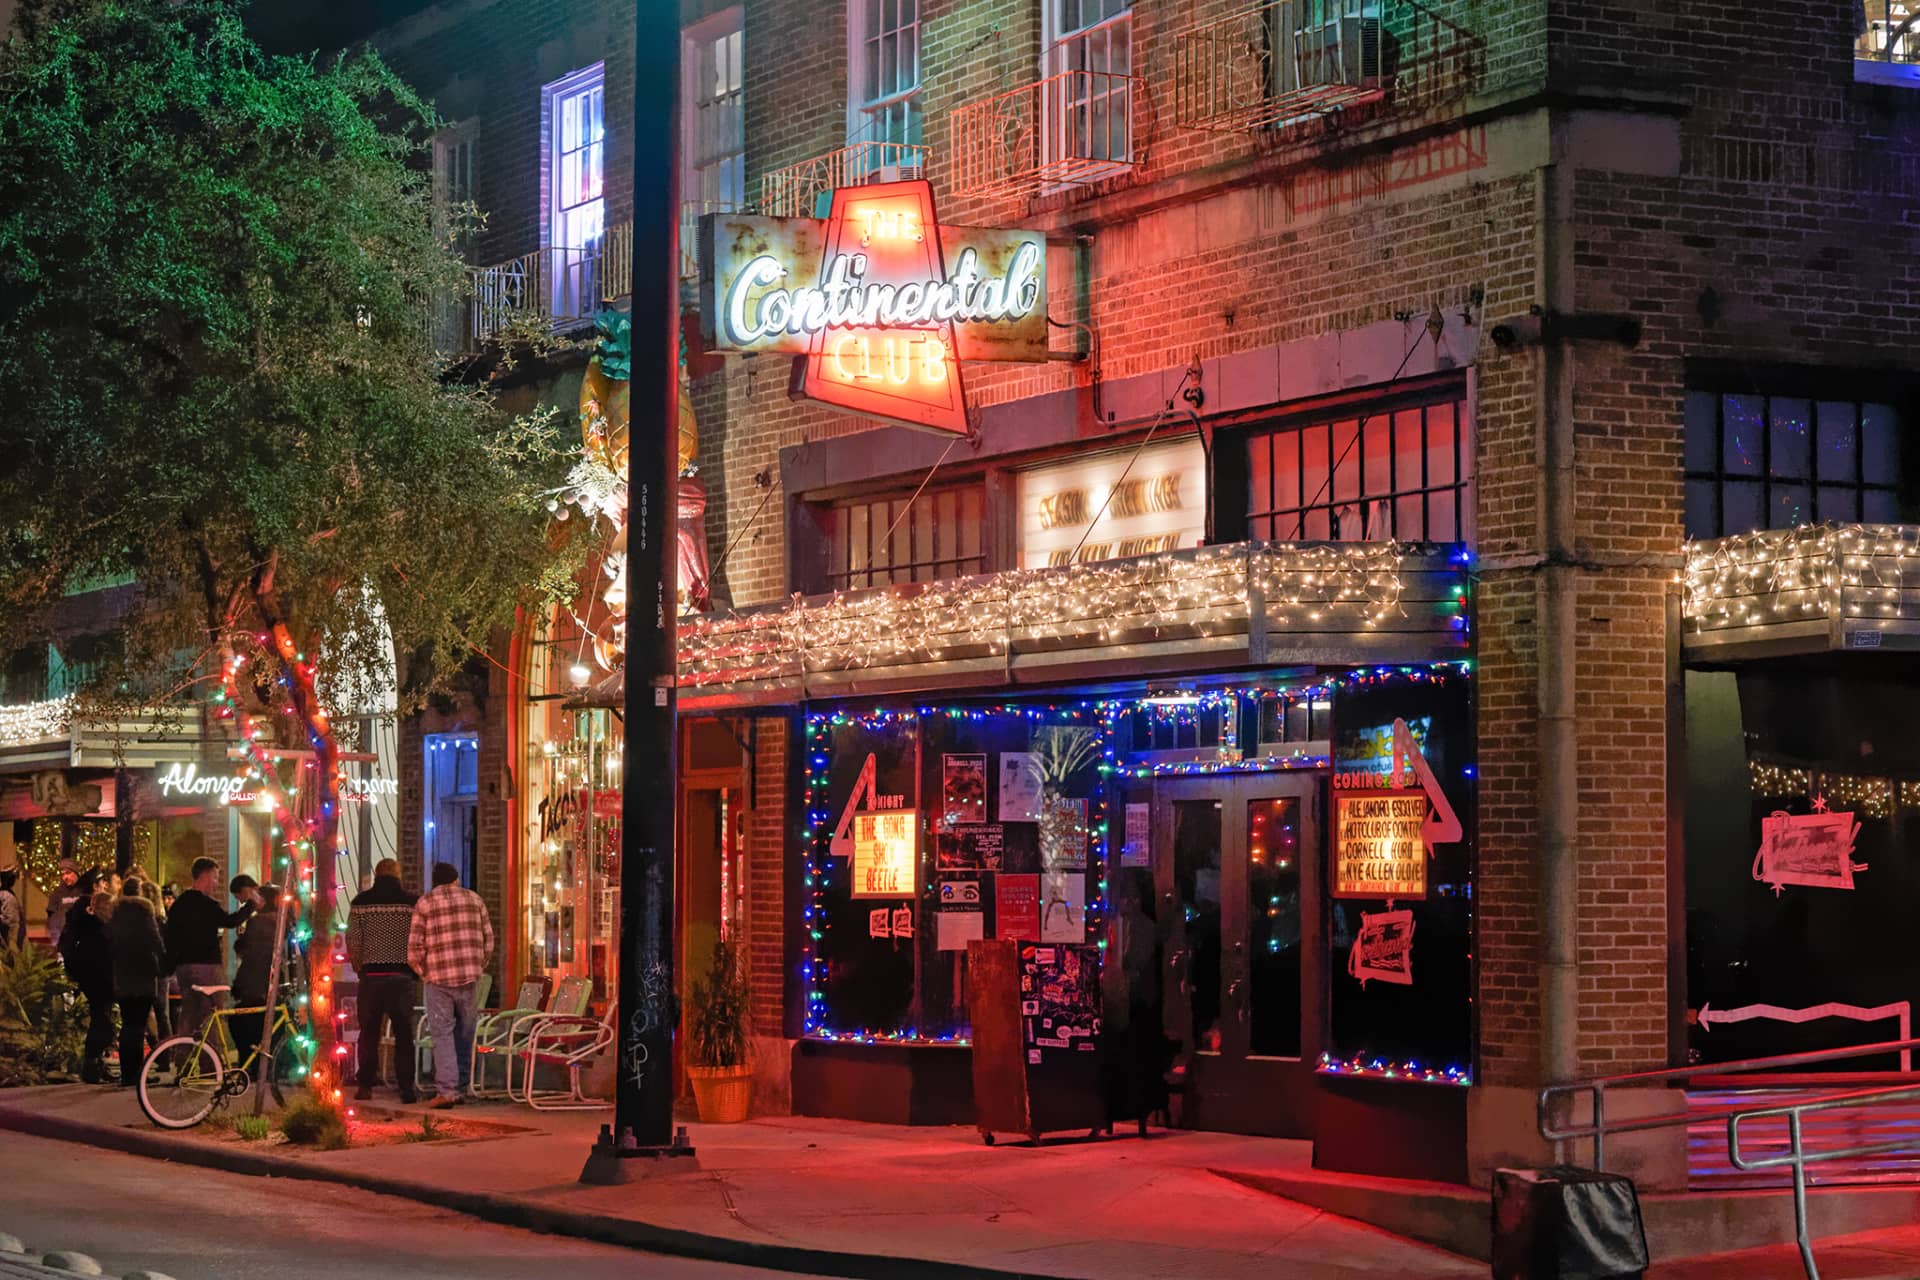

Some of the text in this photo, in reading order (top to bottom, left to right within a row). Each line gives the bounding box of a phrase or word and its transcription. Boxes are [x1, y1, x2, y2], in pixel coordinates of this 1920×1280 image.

[857, 209, 920, 240] THE
[723, 241, 1042, 346] Continental
[832, 333, 949, 386] CLUB
[157, 762, 248, 805] Alonzo
[1333, 771, 1383, 789] COMING
[230, 791, 260, 802] GALLER
[861, 815, 905, 841] THE GONG
[1346, 842, 1413, 860] CORNELL HURD
[867, 867, 898, 892] BEETLE
[1365, 863, 1395, 880] ALLEN
